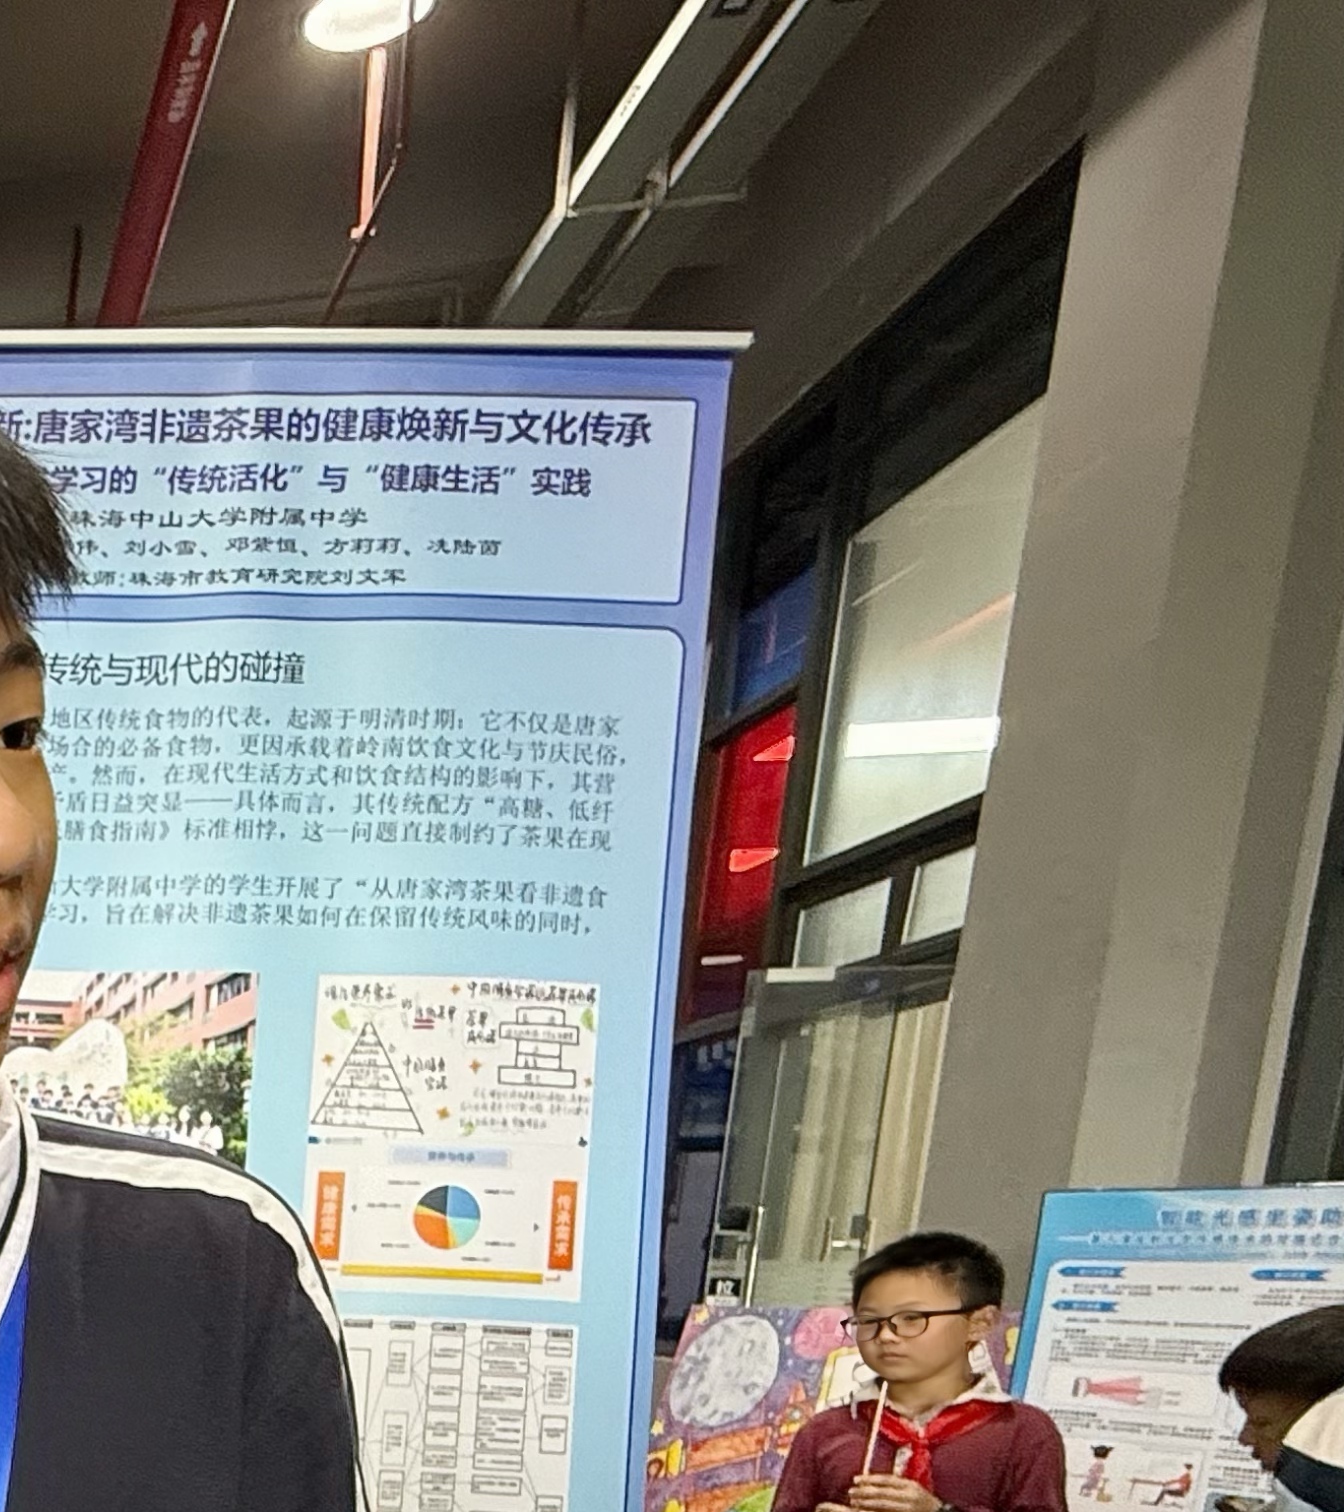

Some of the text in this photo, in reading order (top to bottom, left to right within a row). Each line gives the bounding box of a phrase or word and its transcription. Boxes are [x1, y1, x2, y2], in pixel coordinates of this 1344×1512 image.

[46, 463, 592, 497] 学习的“传统活化”与“健康生活”实践
[45, 651, 305, 687] 传统与现代的碰撞
[55, 790, 614, 823] 盾日益突显——具体而言，其传统配方“高糖、低纤
[58, 819, 612, 851] 膳食指南》标准相悖，这一问题直接制约了茶果在现
[50, 873, 608, 908] 大学附属中学的学生开展了“从唐家湾茶果看非遗食
